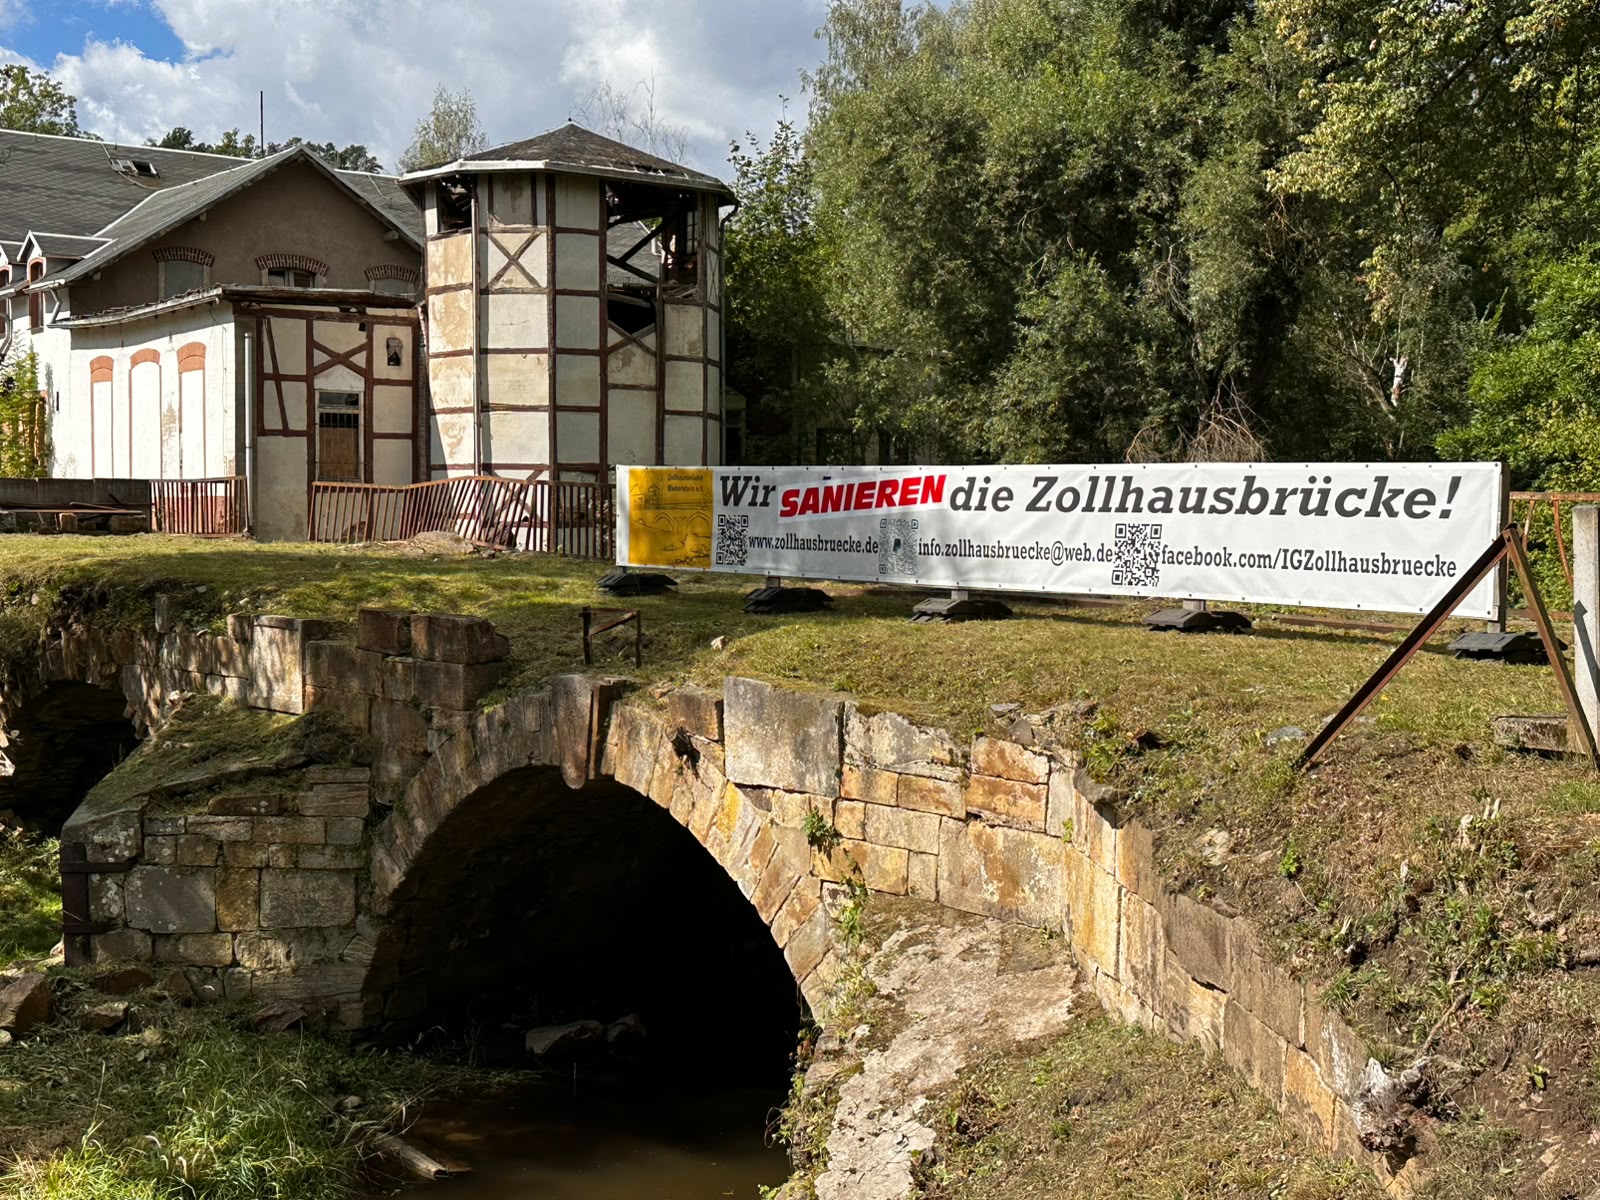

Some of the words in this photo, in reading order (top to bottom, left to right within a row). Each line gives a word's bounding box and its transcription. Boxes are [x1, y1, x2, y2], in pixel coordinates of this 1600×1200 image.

[720, 475, 776, 507] Wir
[779, 474, 946, 518] SANIEREN
[950, 476, 1014, 512] die
[1025, 475, 1462, 519] Zollhausbrücke!
[749, 532, 879, 554] www.zollhausbruecke.de
[918, 537, 1113, 566] info.zollhausbruecke@web.de
[1161, 544, 1457, 577] facebook.com/IGZollhausbruecke
